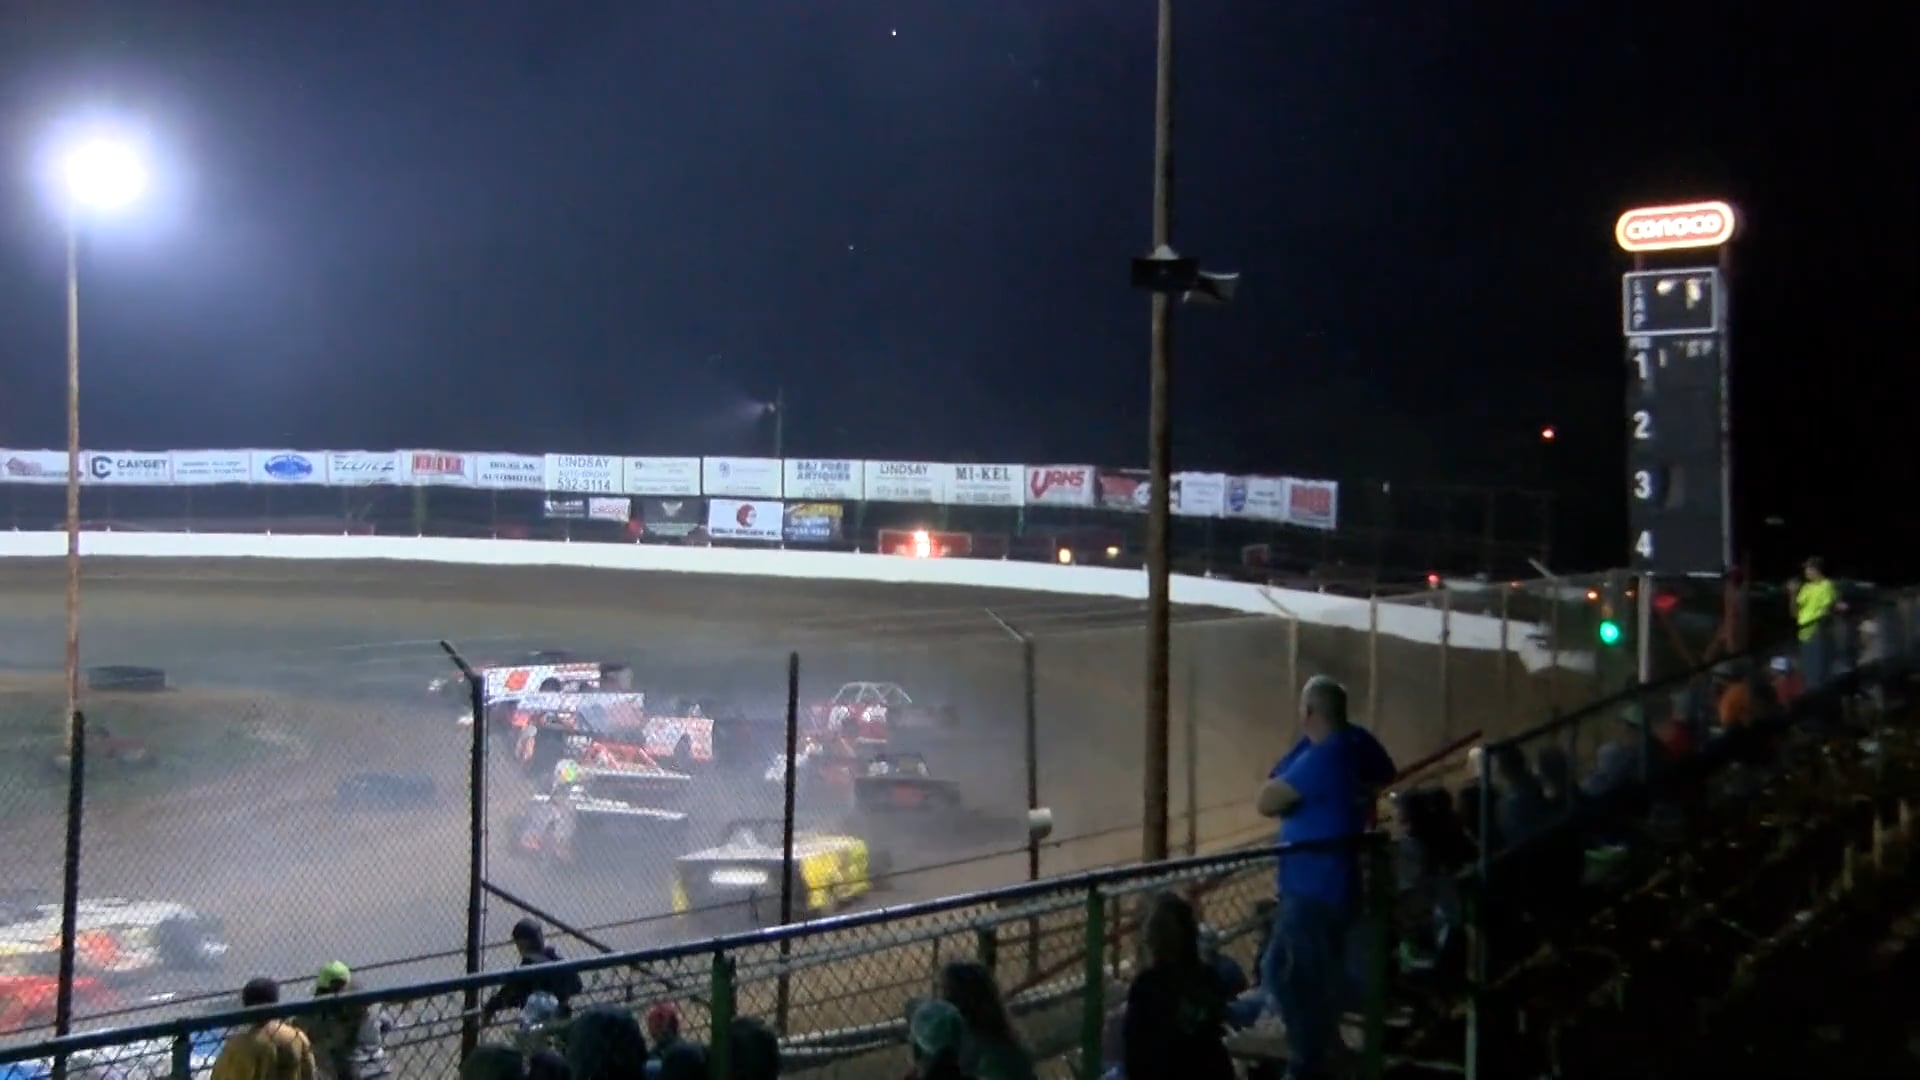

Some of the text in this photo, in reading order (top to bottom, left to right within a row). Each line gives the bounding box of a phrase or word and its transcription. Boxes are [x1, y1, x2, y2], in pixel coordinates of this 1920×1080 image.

[1634, 351, 1648, 380] 1
[1633, 410, 1650, 439] 2
[558, 457, 610, 469] LINDSAY
[879, 463, 929, 475] LINDSAY
[955, 466, 1011, 481] MI-KEL
[1634, 470, 1651, 499] 3
[1635, 530, 1652, 558] 4
